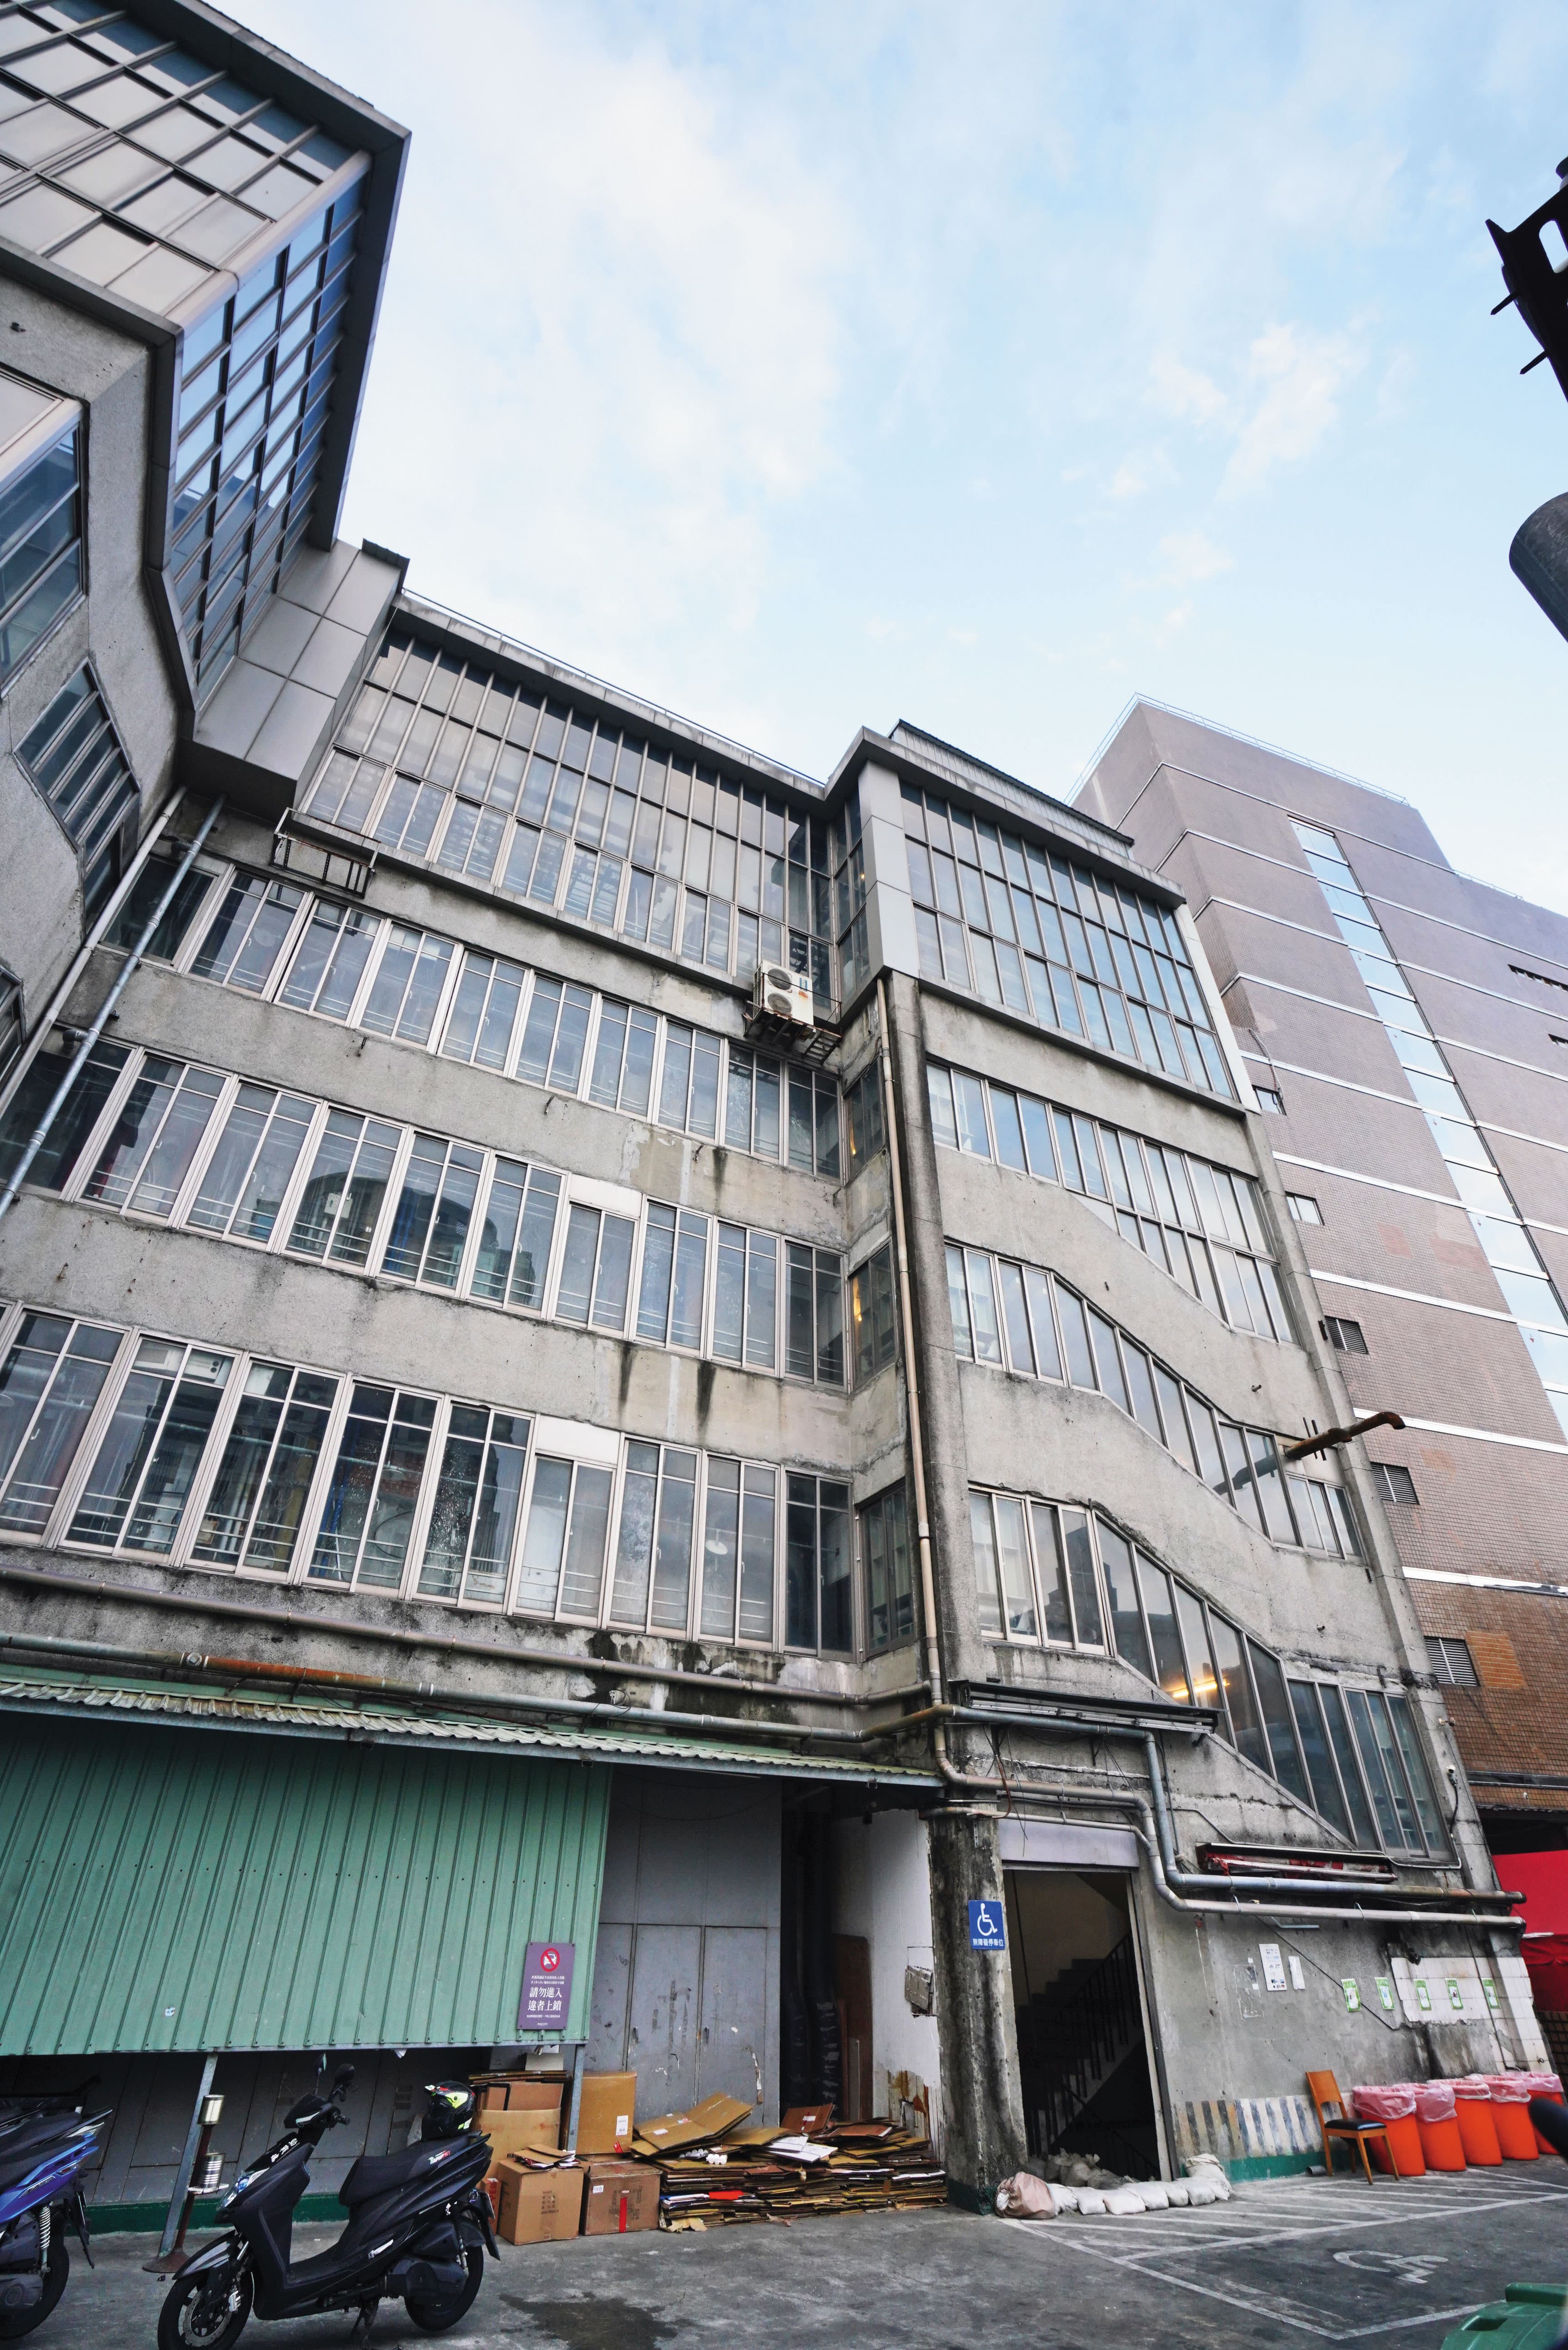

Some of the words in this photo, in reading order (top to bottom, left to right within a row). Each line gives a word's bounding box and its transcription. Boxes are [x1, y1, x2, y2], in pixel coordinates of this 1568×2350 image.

[529, 1986, 563, 1998] 請勿進入
[528, 2000, 562, 2011] 違者上鎖
